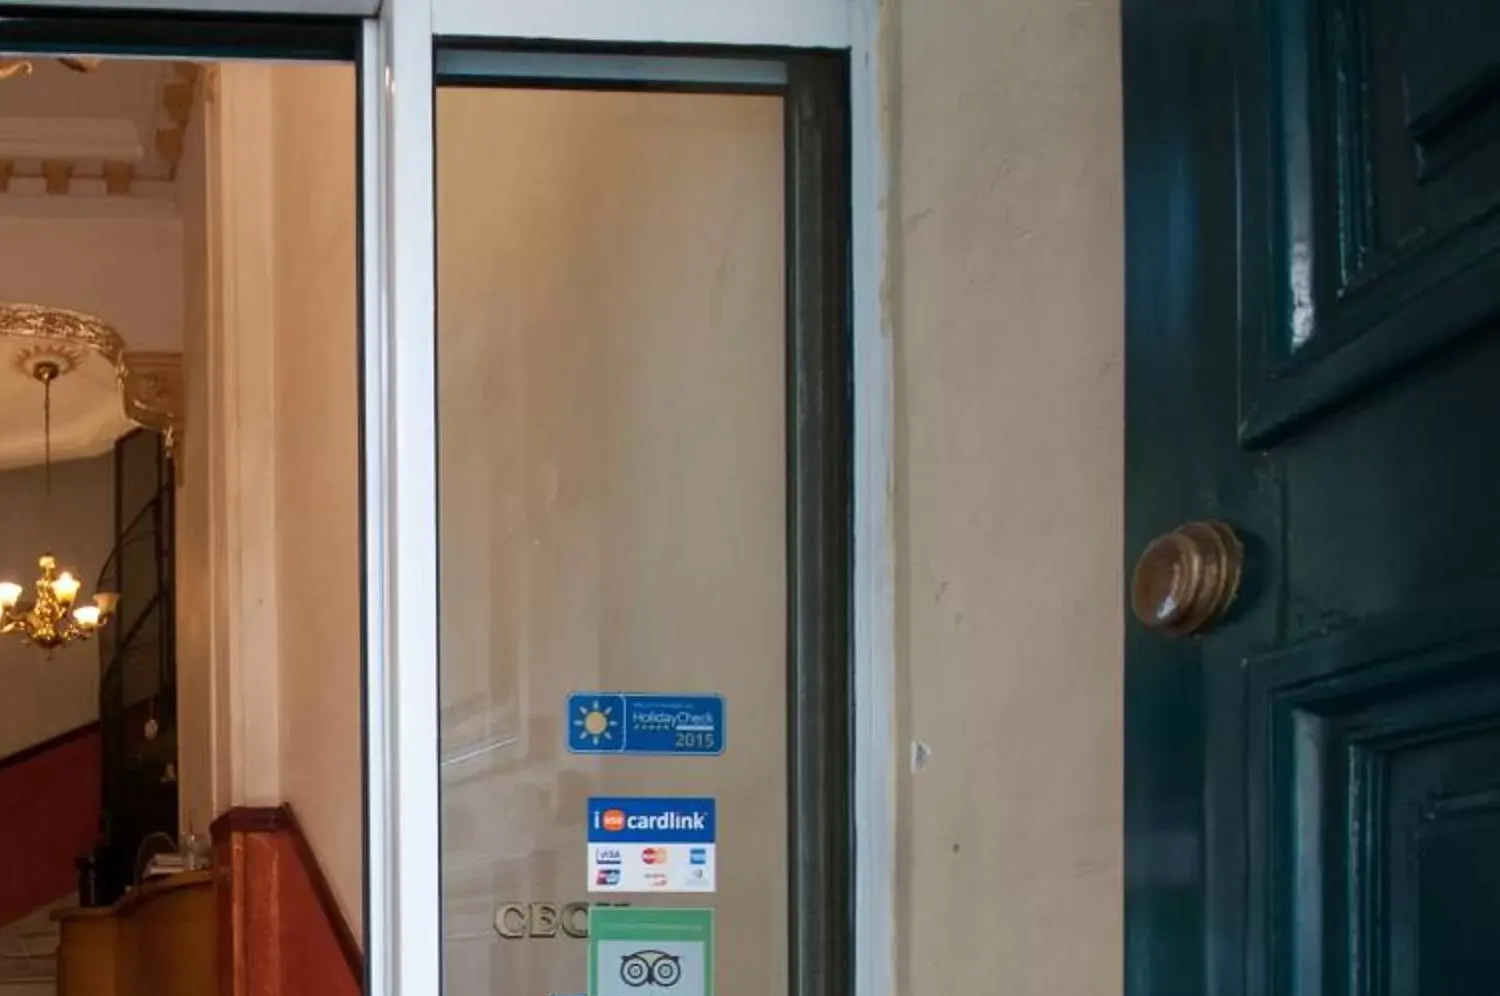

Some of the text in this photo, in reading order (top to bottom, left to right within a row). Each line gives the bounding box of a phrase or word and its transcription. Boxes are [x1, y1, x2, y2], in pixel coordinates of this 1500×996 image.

[632, 711, 714, 728] HolidayCheck
[675, 733, 715, 748] 2015
[627, 811, 705, 830] cardlink
[494, 901, 630, 939] CEC
